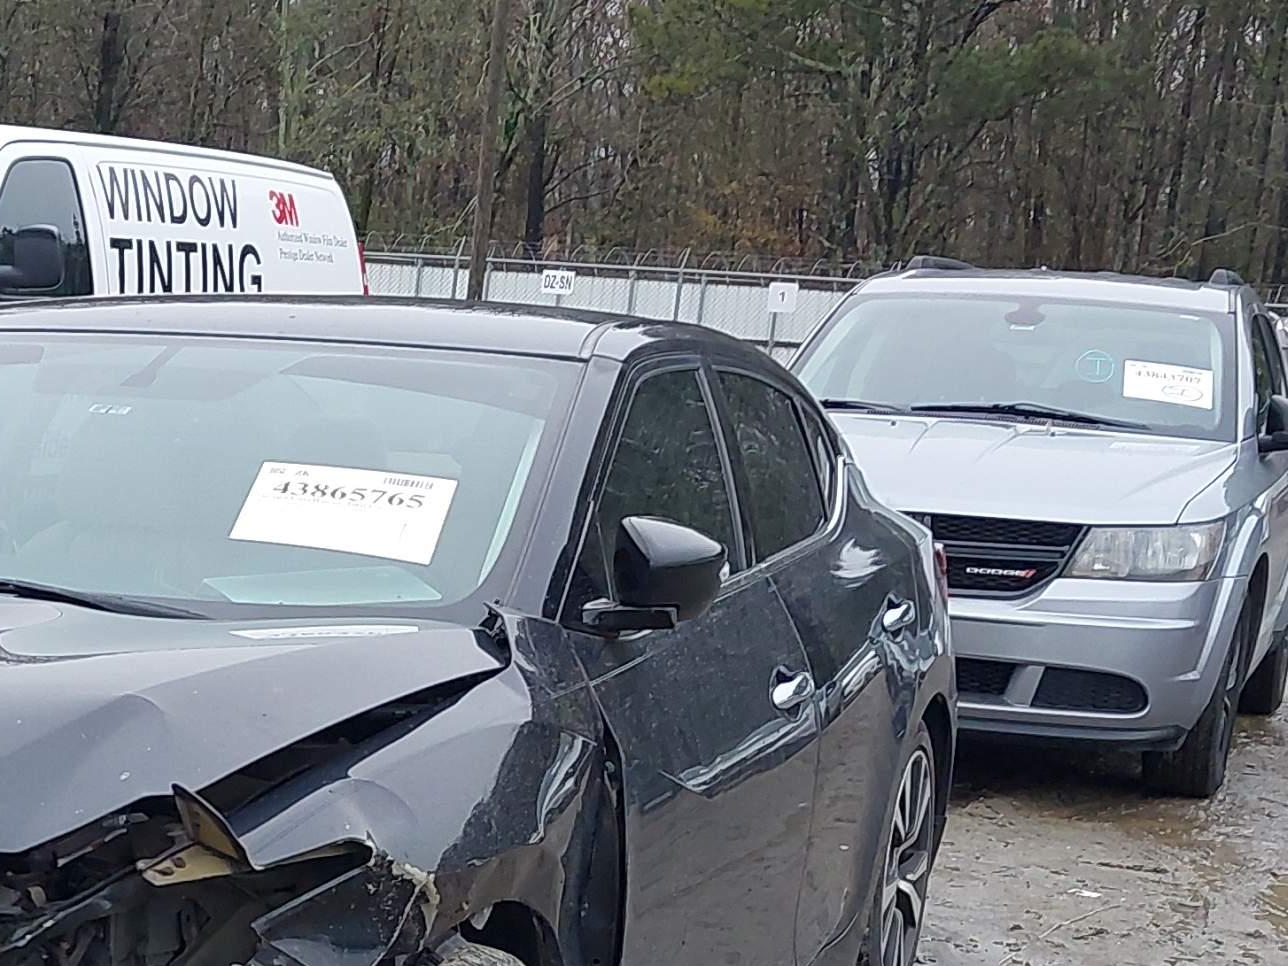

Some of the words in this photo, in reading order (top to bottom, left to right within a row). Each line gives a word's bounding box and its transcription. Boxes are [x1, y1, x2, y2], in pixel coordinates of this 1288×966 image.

[96, 165, 238, 229] WINDOW
[269, 190, 299, 227] 3M
[109, 237, 262, 294] TINTING
[543, 275, 574, 290] DZ-SN
[779, 292, 786, 302] 1
[273, 481, 426, 509] 43865765
[966, 567, 1026, 577] DODGE
